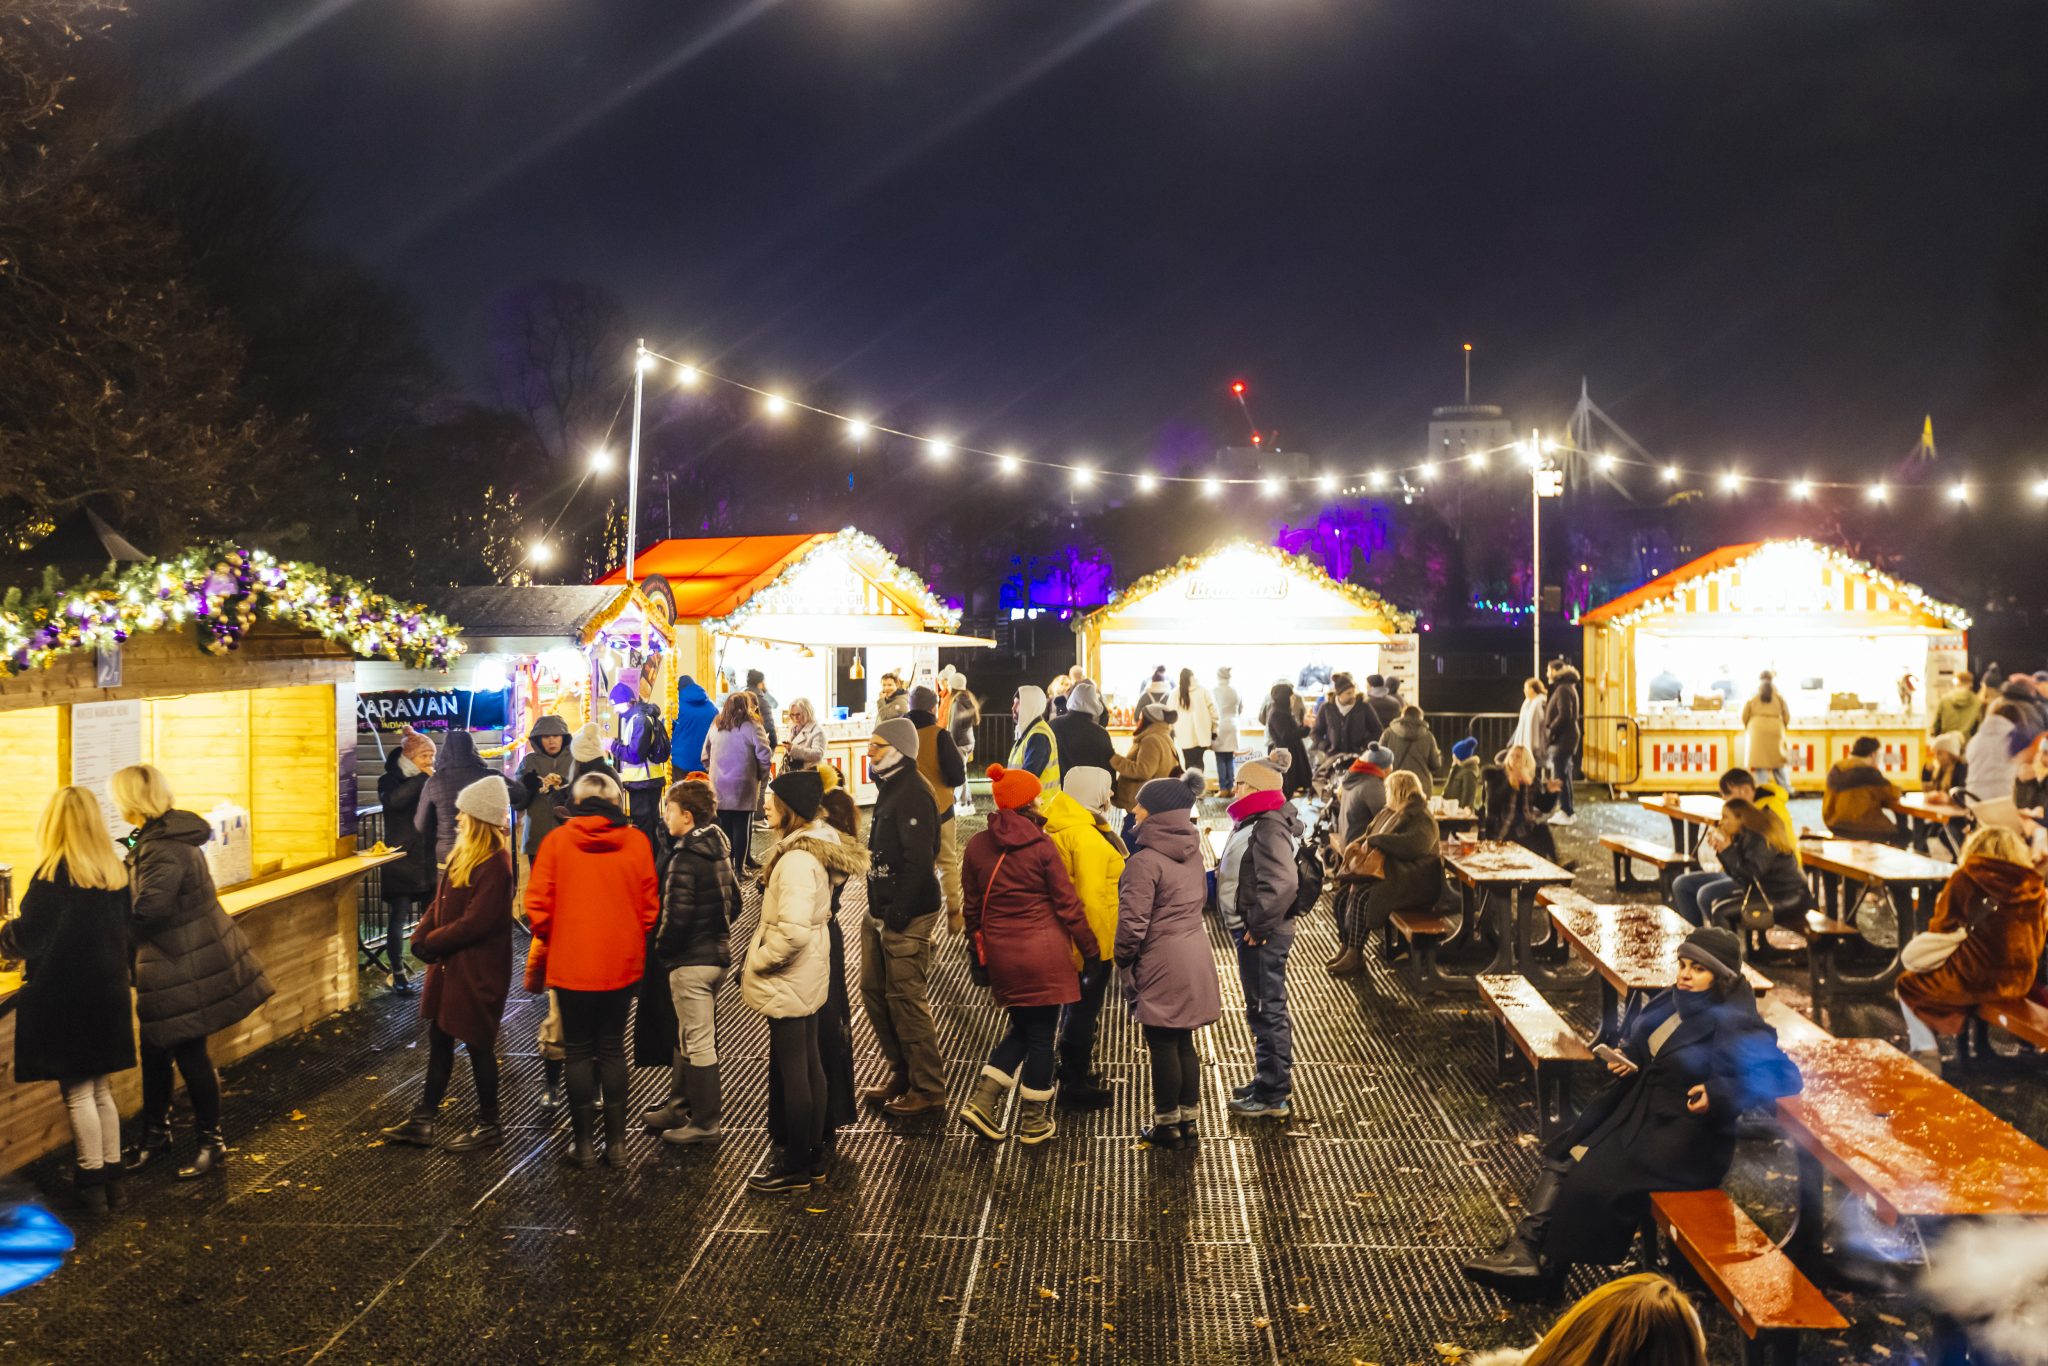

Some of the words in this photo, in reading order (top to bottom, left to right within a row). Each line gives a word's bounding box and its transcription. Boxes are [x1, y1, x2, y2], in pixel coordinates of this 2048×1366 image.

[357, 695, 458, 718] KARAVAN
[381, 720, 410, 729] INDIAN
[413, 720, 448, 729] KITCHEN
